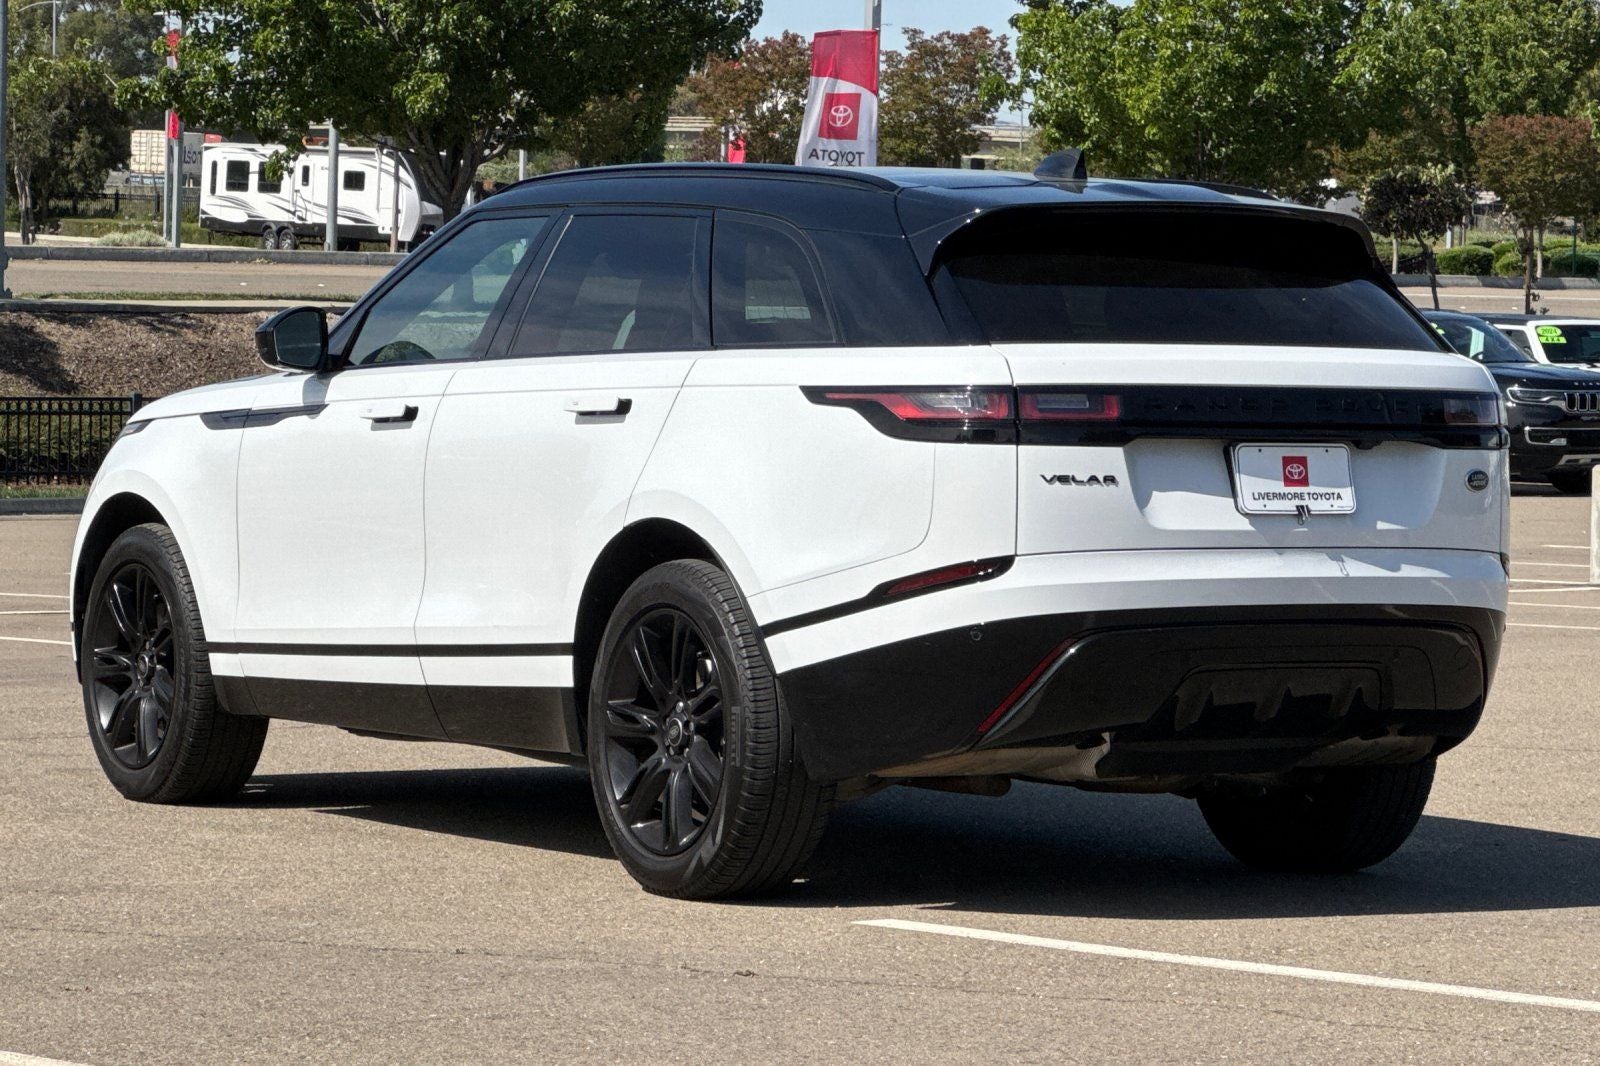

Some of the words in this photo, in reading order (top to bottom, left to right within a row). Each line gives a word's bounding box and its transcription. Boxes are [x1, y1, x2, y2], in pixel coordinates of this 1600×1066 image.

[1040, 475, 1118, 486] VELAR
[1252, 492, 1305, 501] LIVERMORE
[1307, 492, 1343, 501] TOYOTA
